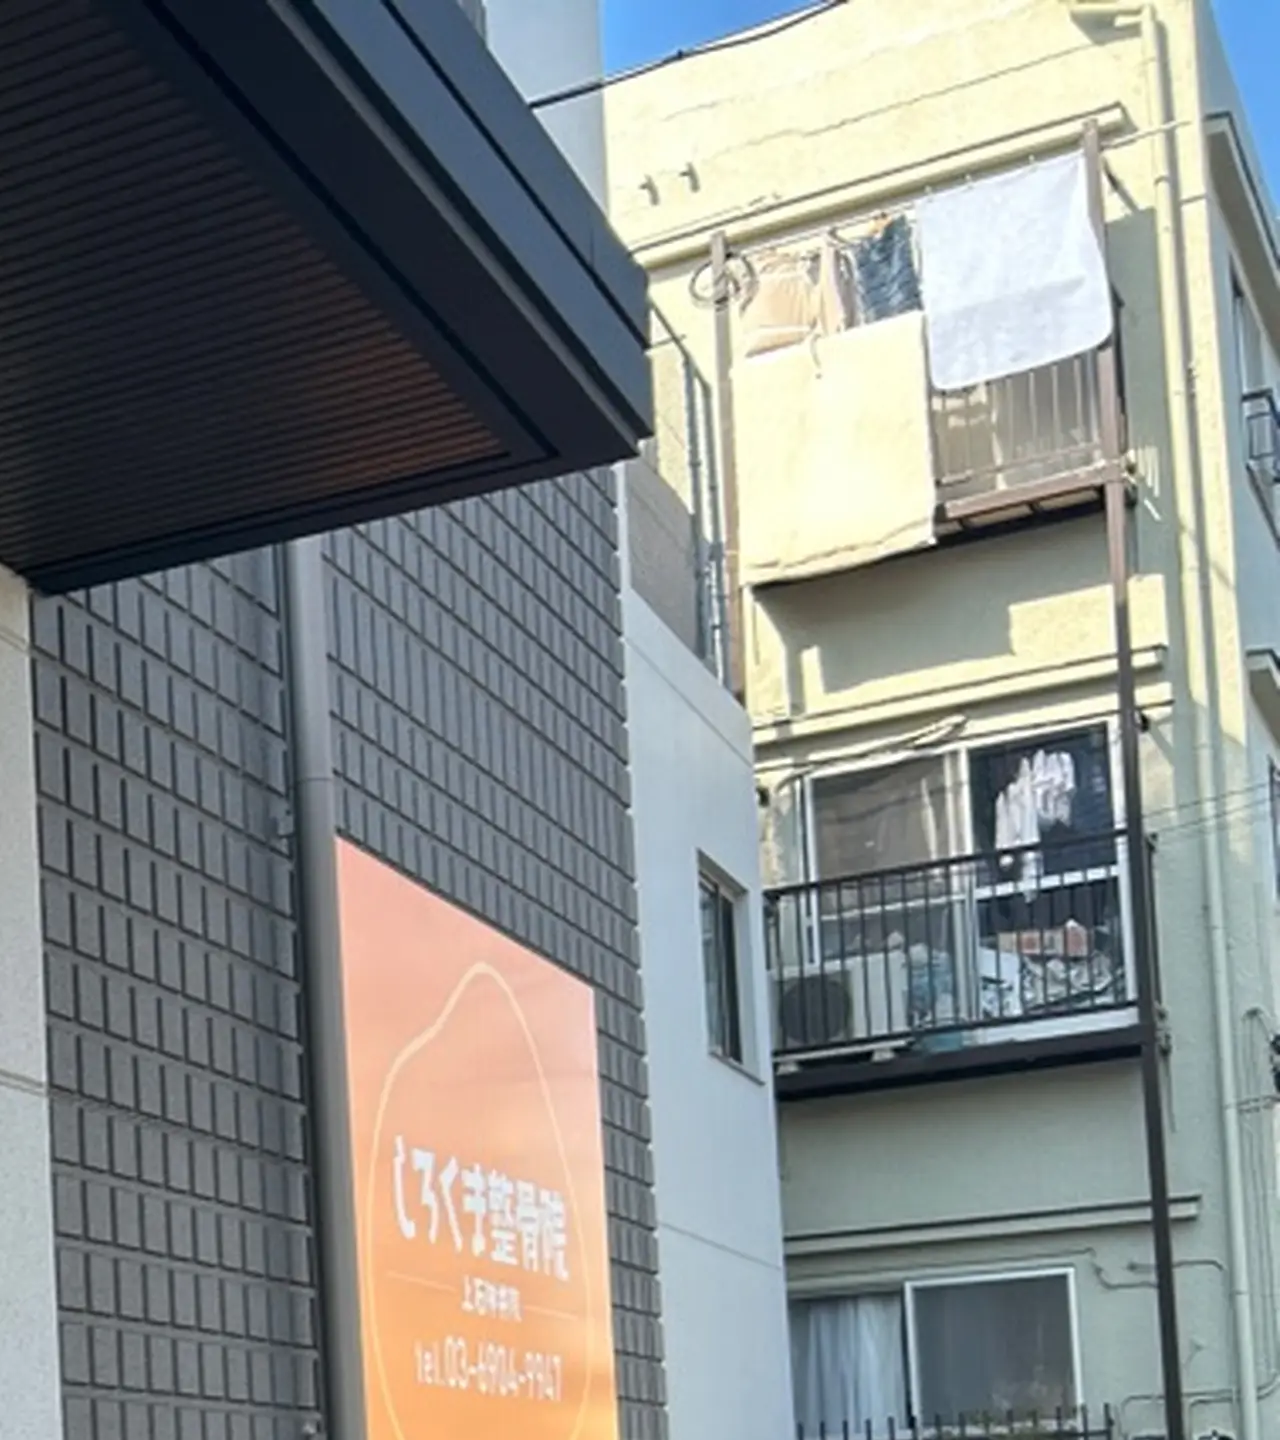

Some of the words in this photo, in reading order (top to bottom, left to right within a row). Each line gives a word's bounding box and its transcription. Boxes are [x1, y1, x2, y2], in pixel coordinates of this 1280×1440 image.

[392, 1134, 569, 1282] しろくま整骨院
